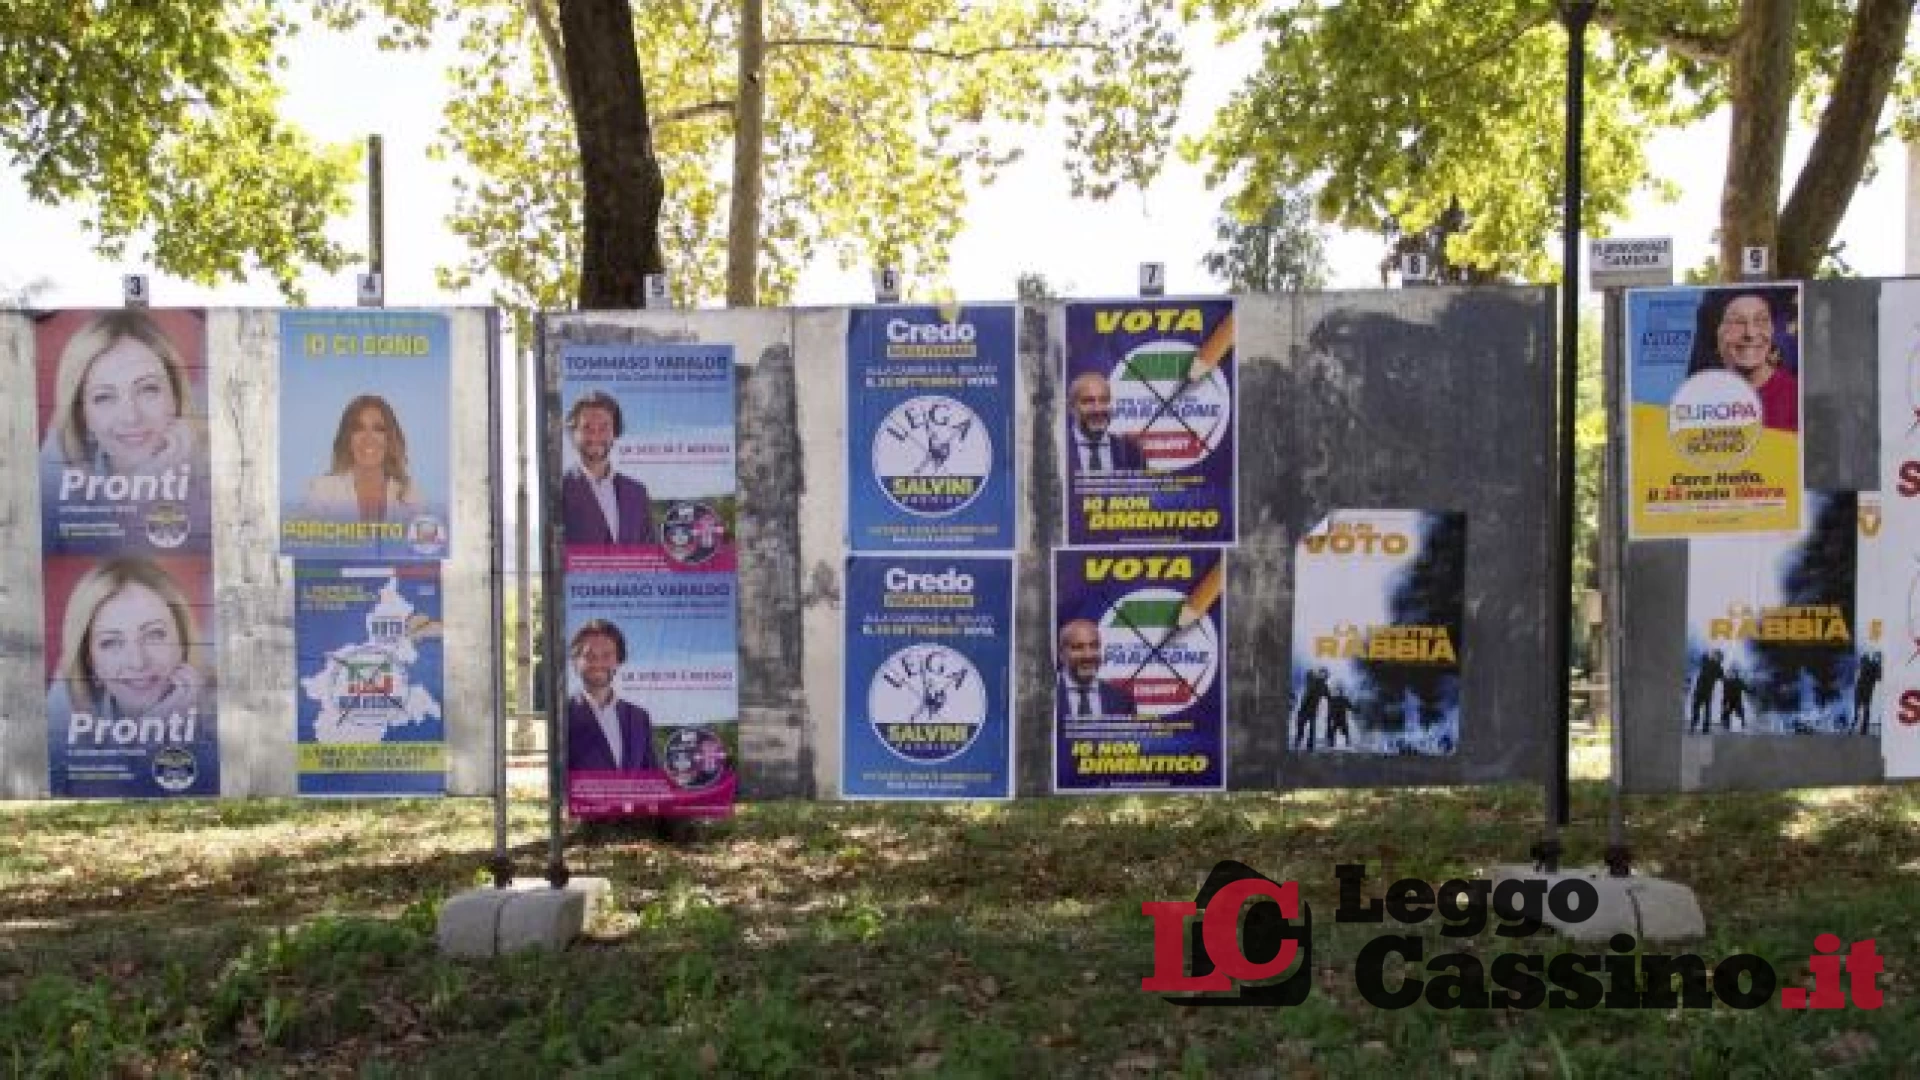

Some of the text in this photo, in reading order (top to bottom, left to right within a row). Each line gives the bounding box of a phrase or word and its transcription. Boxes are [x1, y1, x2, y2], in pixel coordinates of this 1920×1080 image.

[1750, 249, 1762, 268] 9
[1147, 265, 1158, 283] 7
[130, 277, 141, 296] 3
[887, 318, 977, 343] Credo
[1095, 308, 1203, 334] VOTA
[886, 403, 972, 442] LEGA
[59, 468, 190, 501] Pronti
[893, 477, 974, 495] SALVINI
[1084, 496, 1150, 513] IO NON
[1089, 512, 1220, 531] DIMENTICO
[1304, 533, 1408, 555] VOTO
[884, 567, 975, 592] Credo
[1085, 556, 1193, 581] VOTA
[1710, 618, 1850, 641] RABBIA
[1315, 636, 1456, 661] RABBIA
[883, 651, 968, 691] LEGA
[67, 710, 195, 744] Pronti
[889, 725, 968, 742] SALVINI
[1097, 741, 1142, 754] NON
[1077, 756, 1210, 775] DIMENTICO
